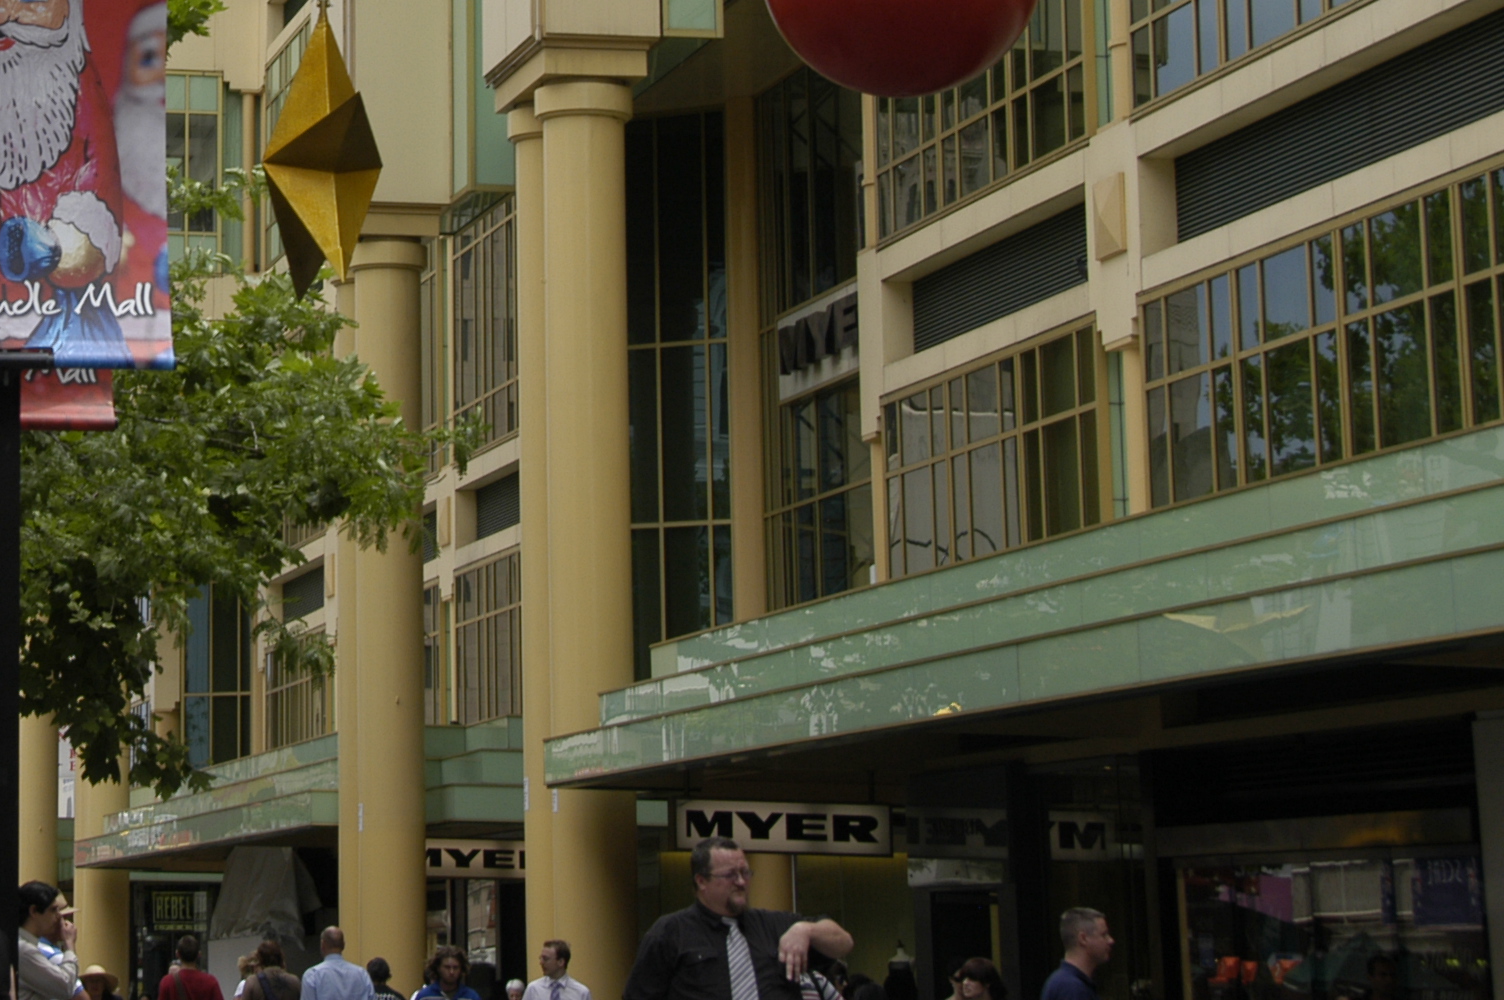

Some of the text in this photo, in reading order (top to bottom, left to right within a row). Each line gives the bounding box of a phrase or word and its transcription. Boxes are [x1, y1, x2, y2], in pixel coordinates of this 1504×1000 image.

[74, 281, 156, 317] Mall
[684, 808, 880, 844] MYER
[426, 848, 525, 869] YE
[156, 896, 191, 919] REBEL
